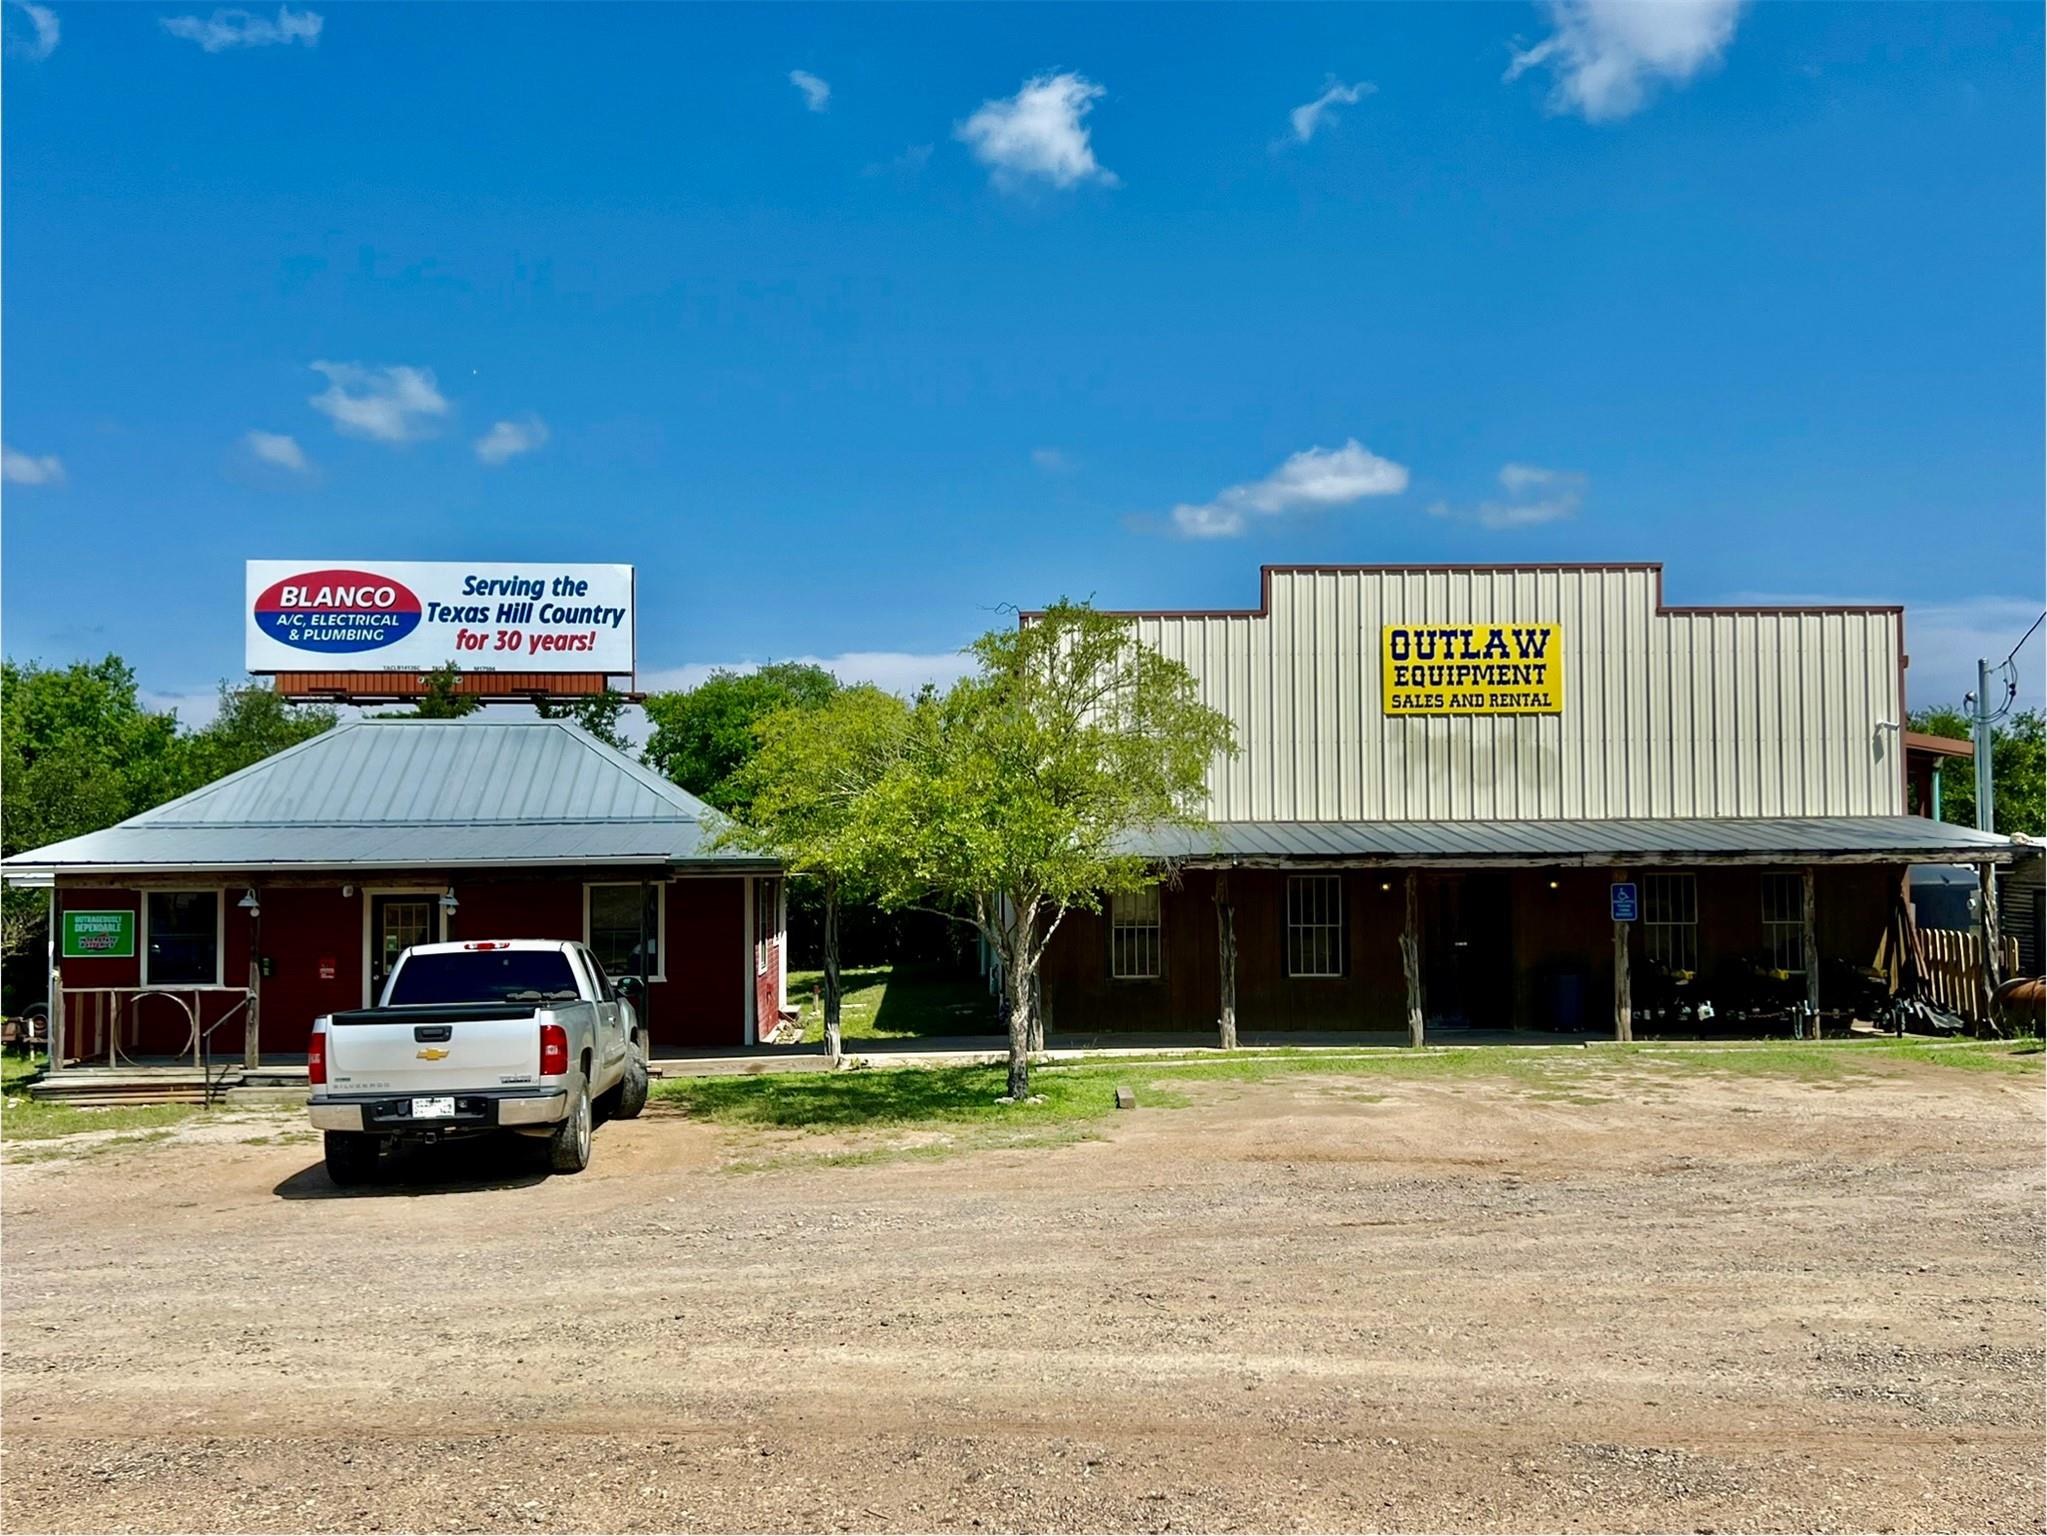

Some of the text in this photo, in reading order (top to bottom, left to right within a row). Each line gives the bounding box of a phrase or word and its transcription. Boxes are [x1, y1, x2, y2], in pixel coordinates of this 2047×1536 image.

[280, 586, 396, 608] BLANCO
[462, 575, 588, 601] Serving the
[276, 614, 399, 627] A/C, ELECTRICAL
[427, 602, 626, 628] Texas Hill Country
[288, 629, 384, 641] & PLUMBING
[456, 628, 596, 655] for 30 years!
[1390, 629, 1551, 661] OUTLAW
[1394, 664, 1547, 688] EQUIPMENT
[1391, 693, 1552, 708] SALES AND RENTAL
[75, 923, 121, 932] DEPENDABLE
